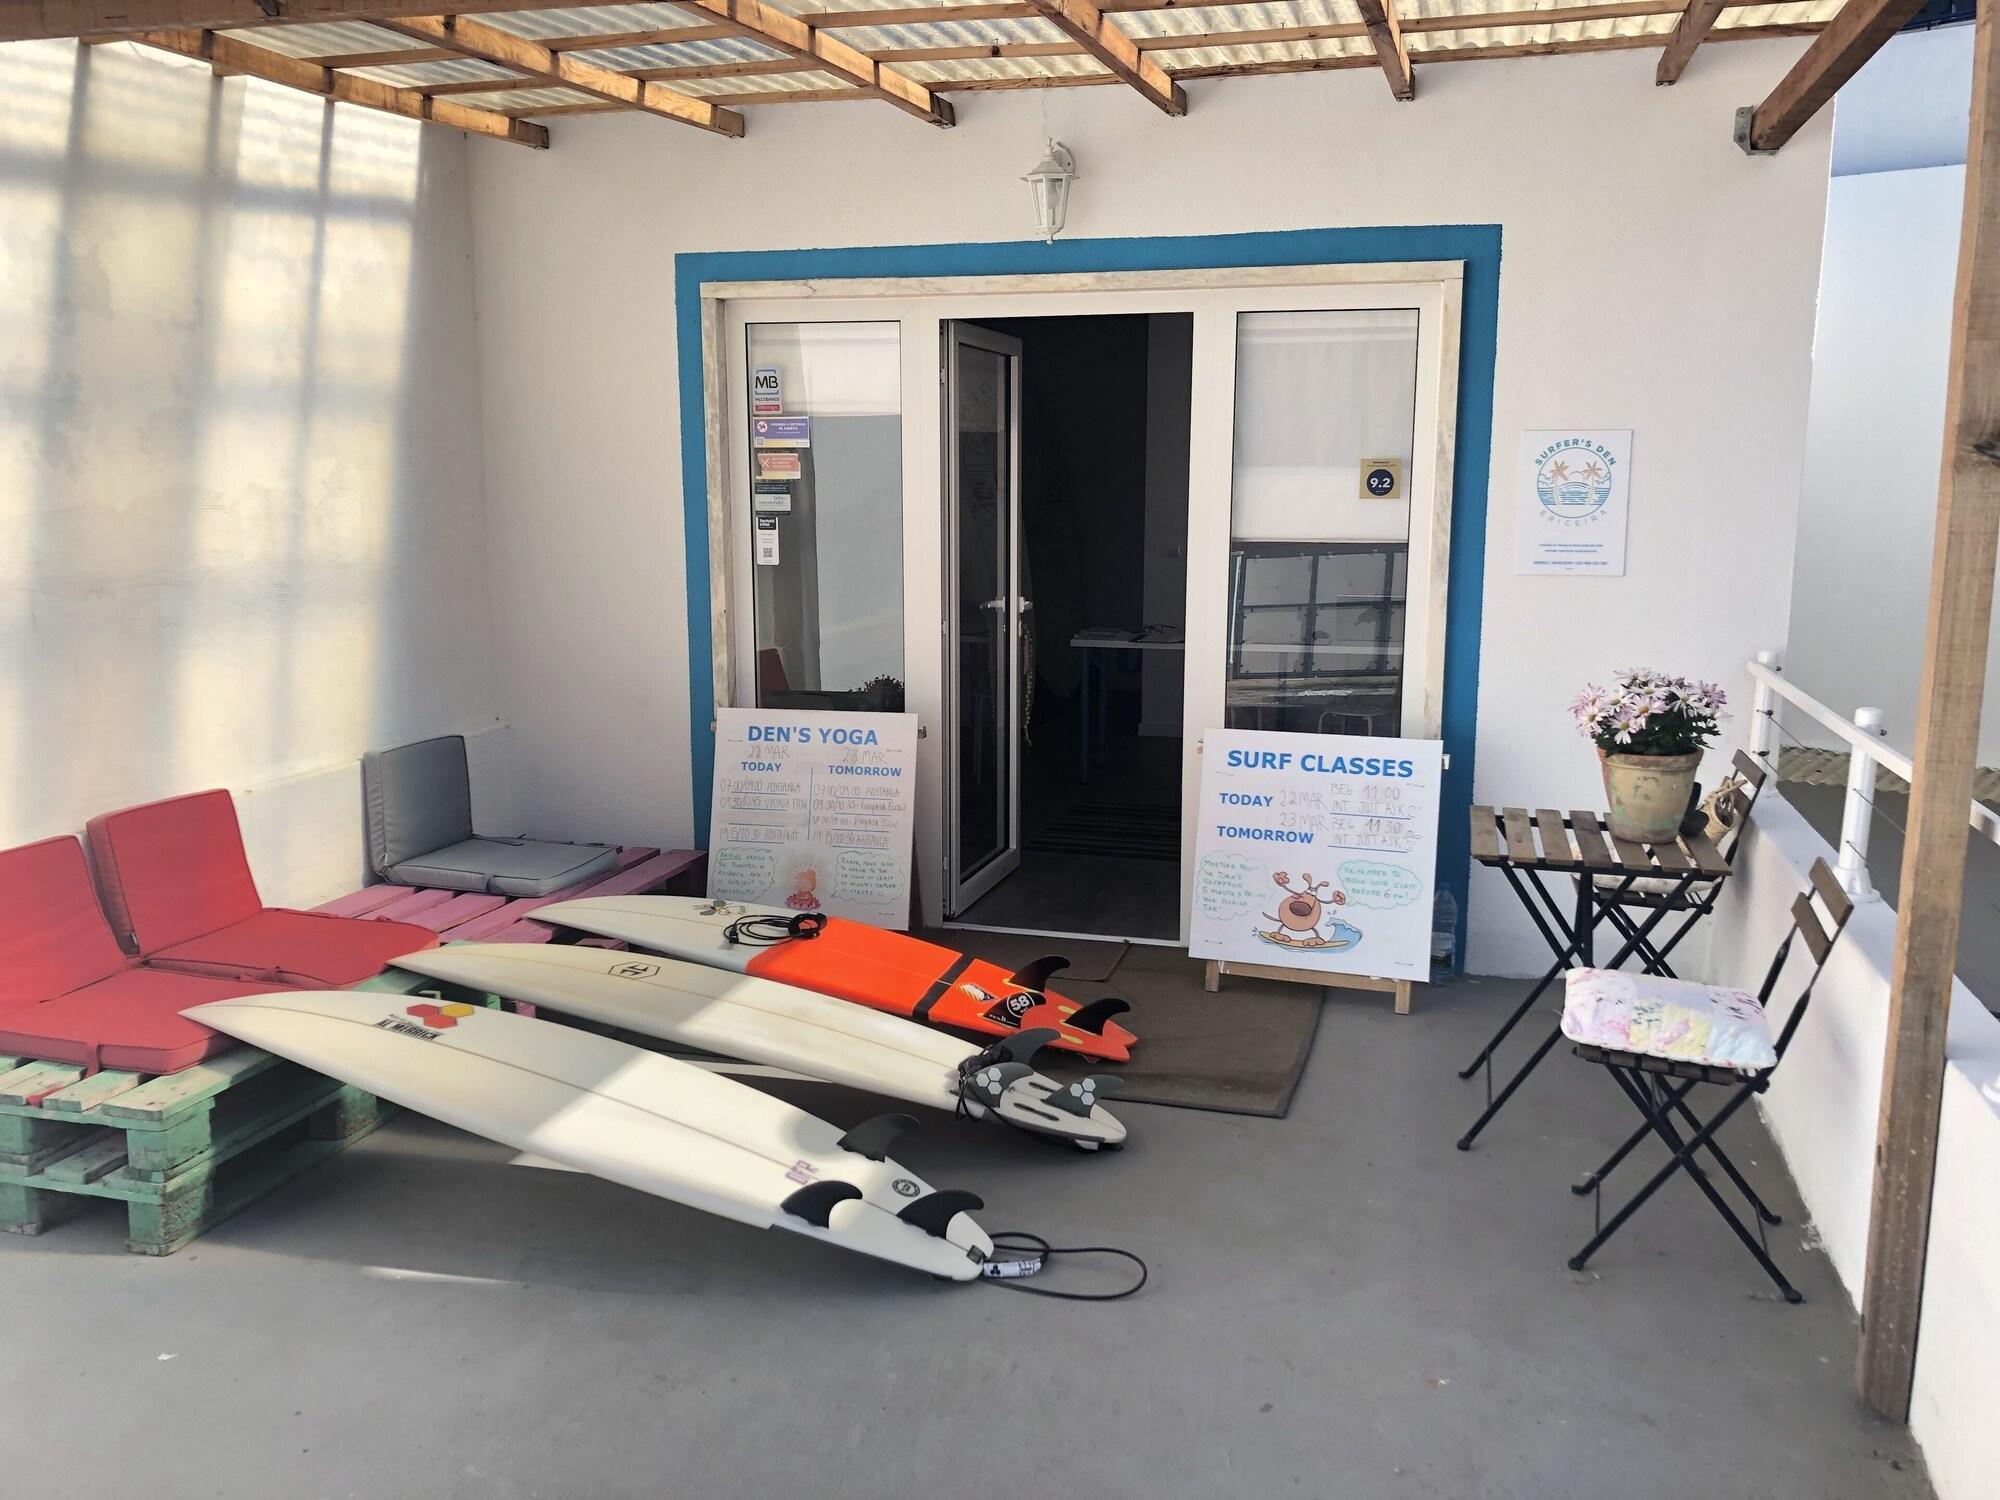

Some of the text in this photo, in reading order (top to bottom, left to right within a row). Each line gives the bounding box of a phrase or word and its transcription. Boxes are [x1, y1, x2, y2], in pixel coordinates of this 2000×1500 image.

[755, 375, 779, 389] MB
[1535, 438, 1617, 466] SURFER'S DEN
[1370, 477, 1391, 488] 9.2
[747, 725, 878, 745] DEN'S YOGA
[741, 761, 782, 772] TODAY
[828, 764, 902, 777] TOMORROW
[1227, 749, 1413, 778] SURF CLASSES
[1219, 792, 1274, 808] TODAY
[1300, 791, 1329, 811] MAR
[1280, 812, 1297, 828] 23
[1217, 825, 1315, 844] TOMORROW
[1010, 994, 1031, 1011] 58
